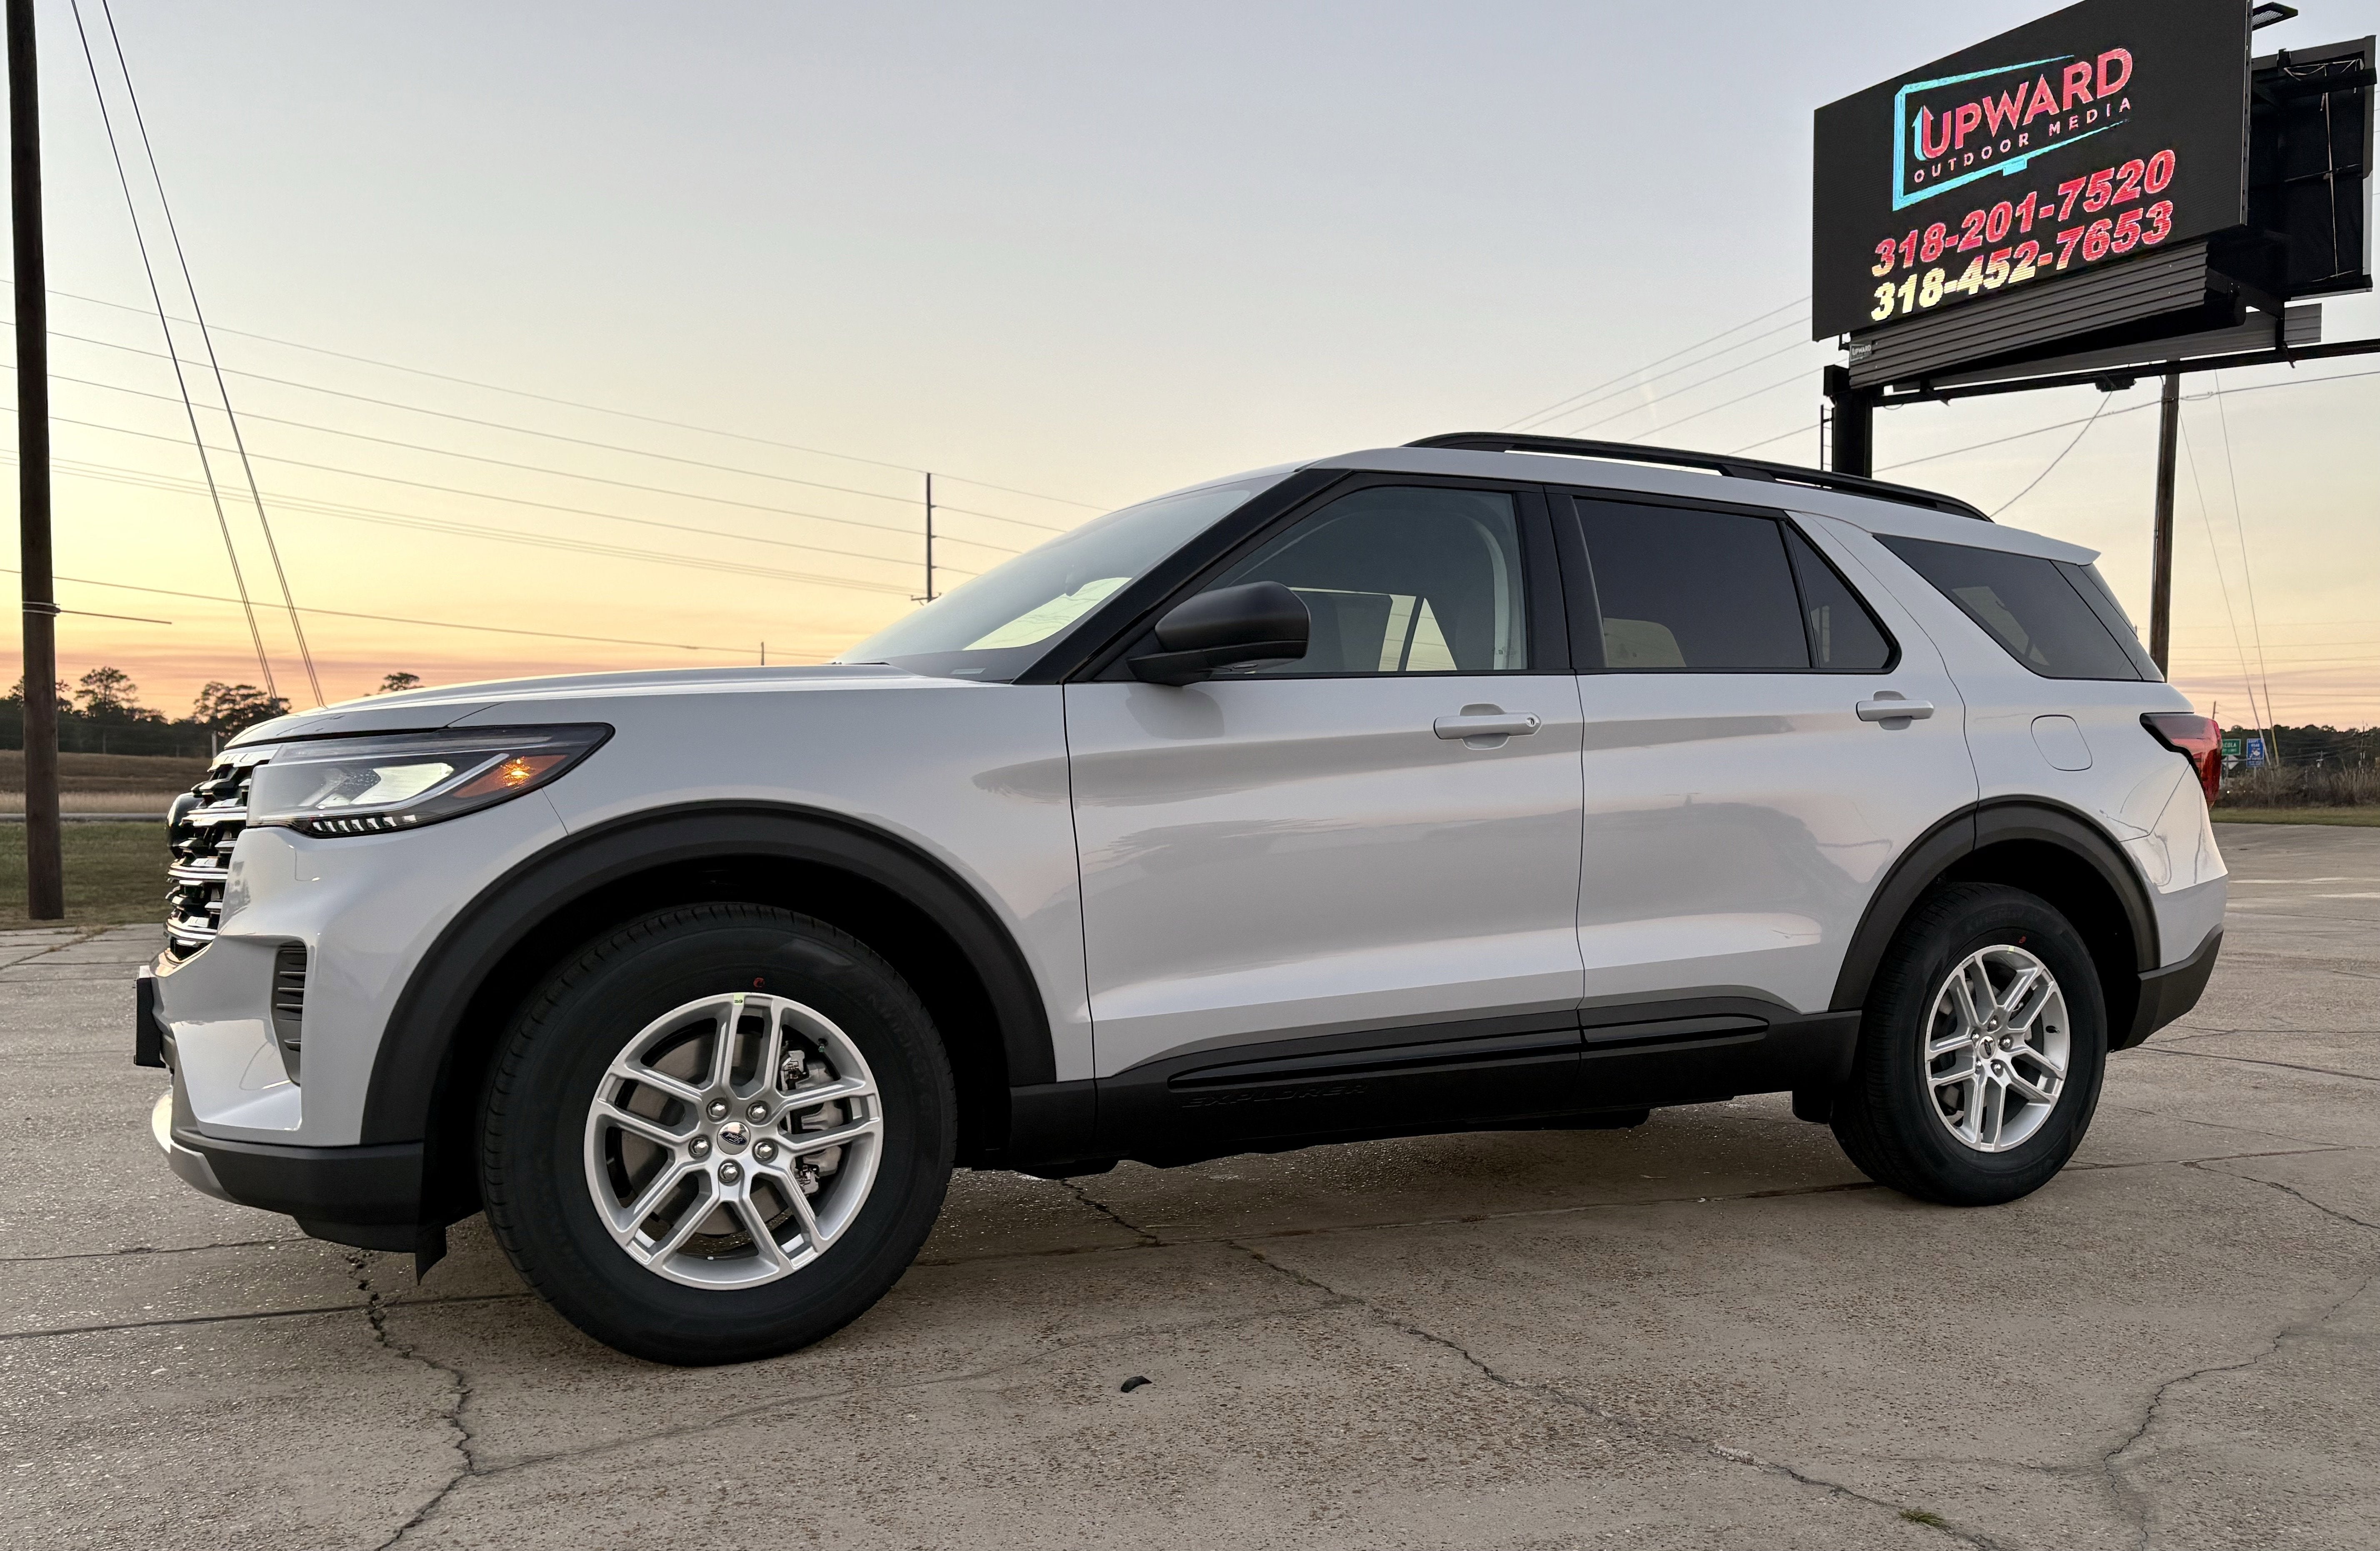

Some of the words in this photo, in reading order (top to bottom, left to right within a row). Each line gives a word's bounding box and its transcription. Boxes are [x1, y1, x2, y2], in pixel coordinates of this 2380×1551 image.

[1913, 48, 2132, 162] UPWARD
[1914, 133, 2029, 183] OUTDOOR
[2049, 98, 2132, 136] MEDIA
[1870, 200, 2174, 322] 318-452-7653
[1871, 149, 2175, 277] 318-201-7520
[725, 1133, 743, 1143] Ford
[1182, 1085, 1368, 1108] EXPLORER
